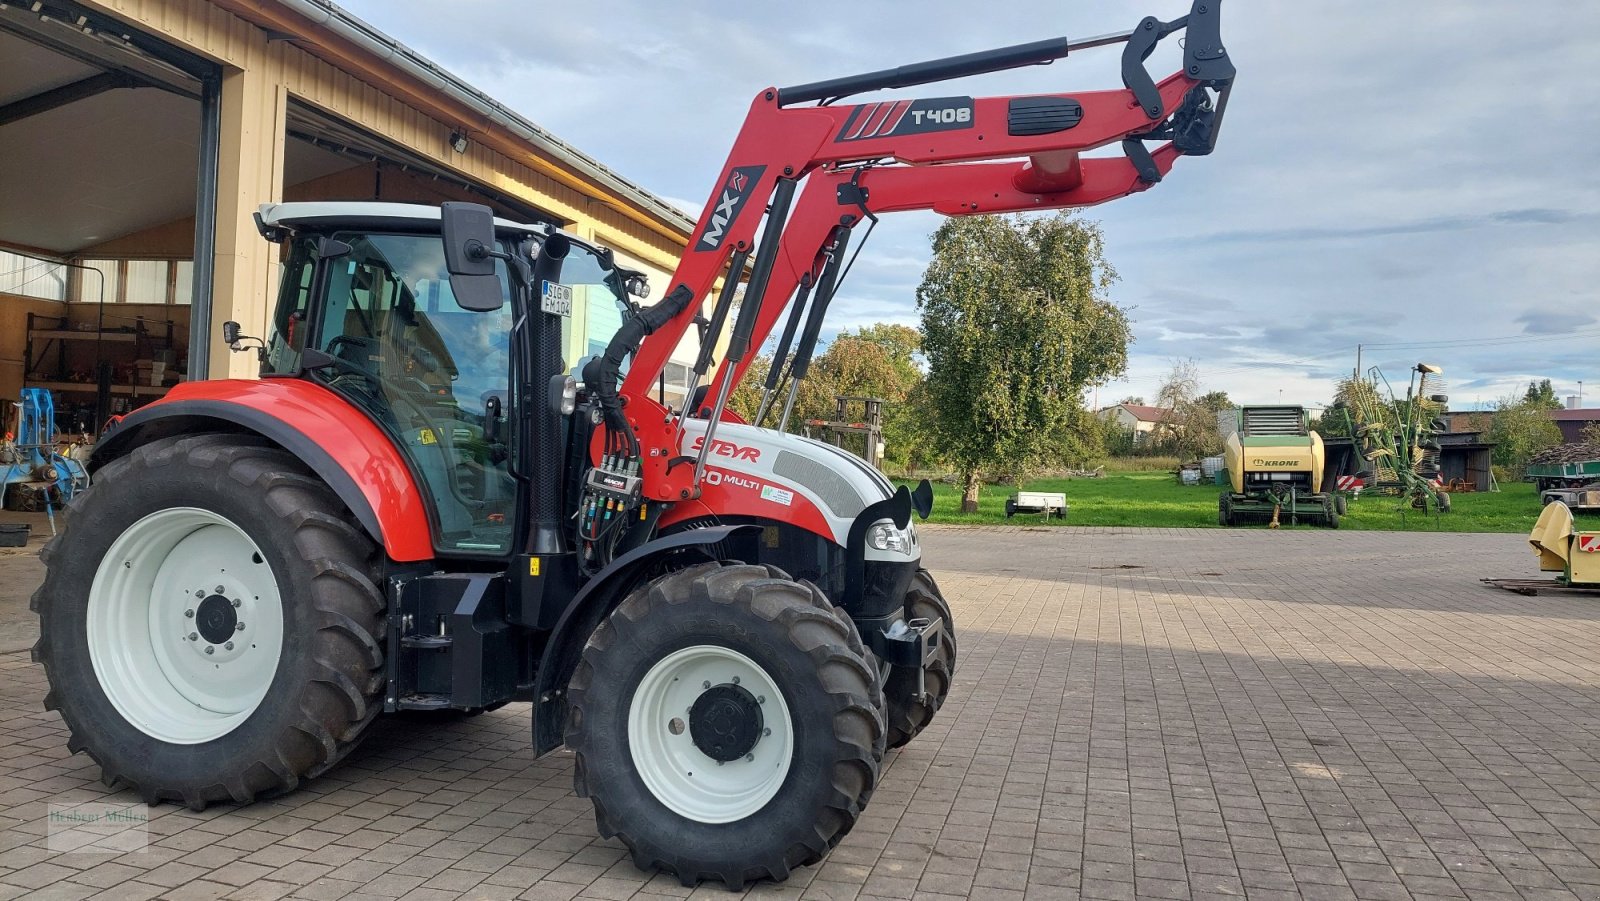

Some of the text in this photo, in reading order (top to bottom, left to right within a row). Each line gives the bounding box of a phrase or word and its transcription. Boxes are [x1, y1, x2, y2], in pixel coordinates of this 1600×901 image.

[911, 107, 971, 125] T408
[702, 189, 740, 247] MX
[549, 285, 562, 299] SIG
[691, 437, 761, 463] STEYR
[723, 475, 759, 490] MULTI
